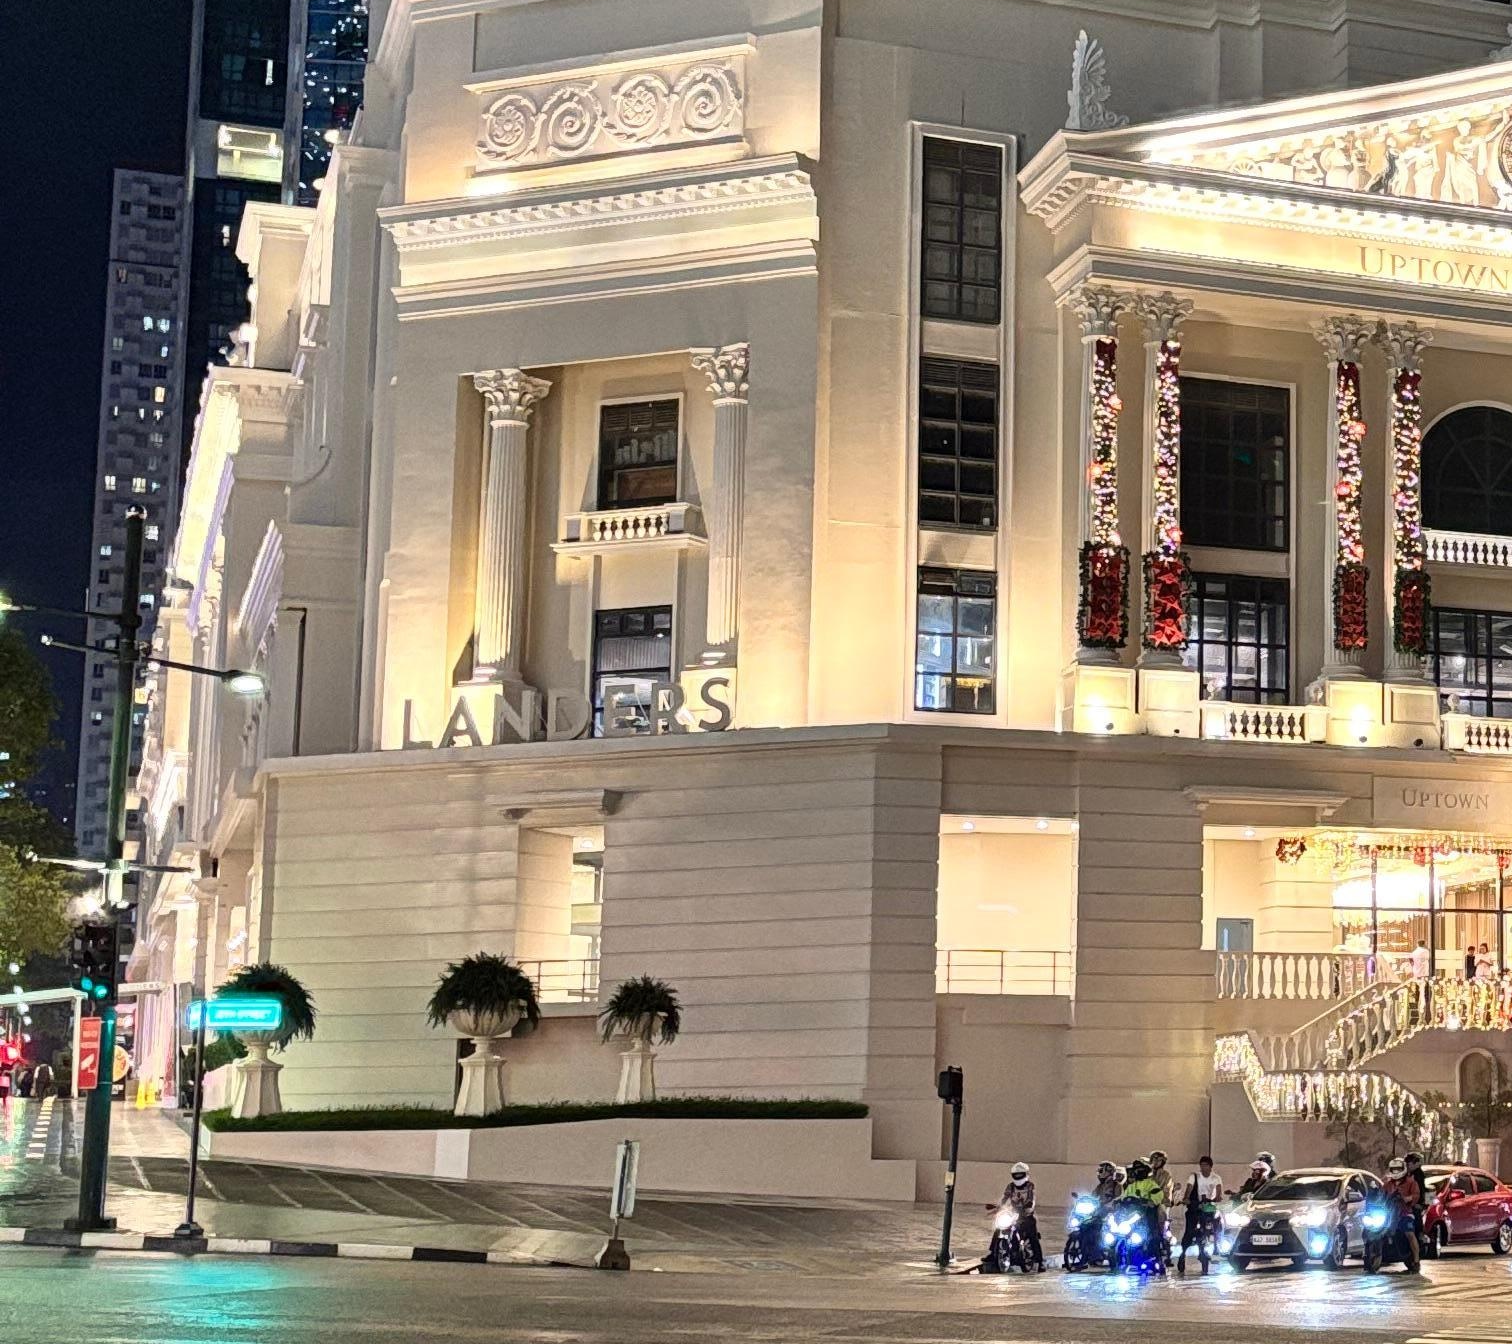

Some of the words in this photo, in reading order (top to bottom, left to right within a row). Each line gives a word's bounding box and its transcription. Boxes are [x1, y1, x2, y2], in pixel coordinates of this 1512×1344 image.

[1359, 245, 1511, 291] UPTOWN
[402, 676, 734, 751] LANDERS
[1401, 787, 1489, 811] UPTOWN
